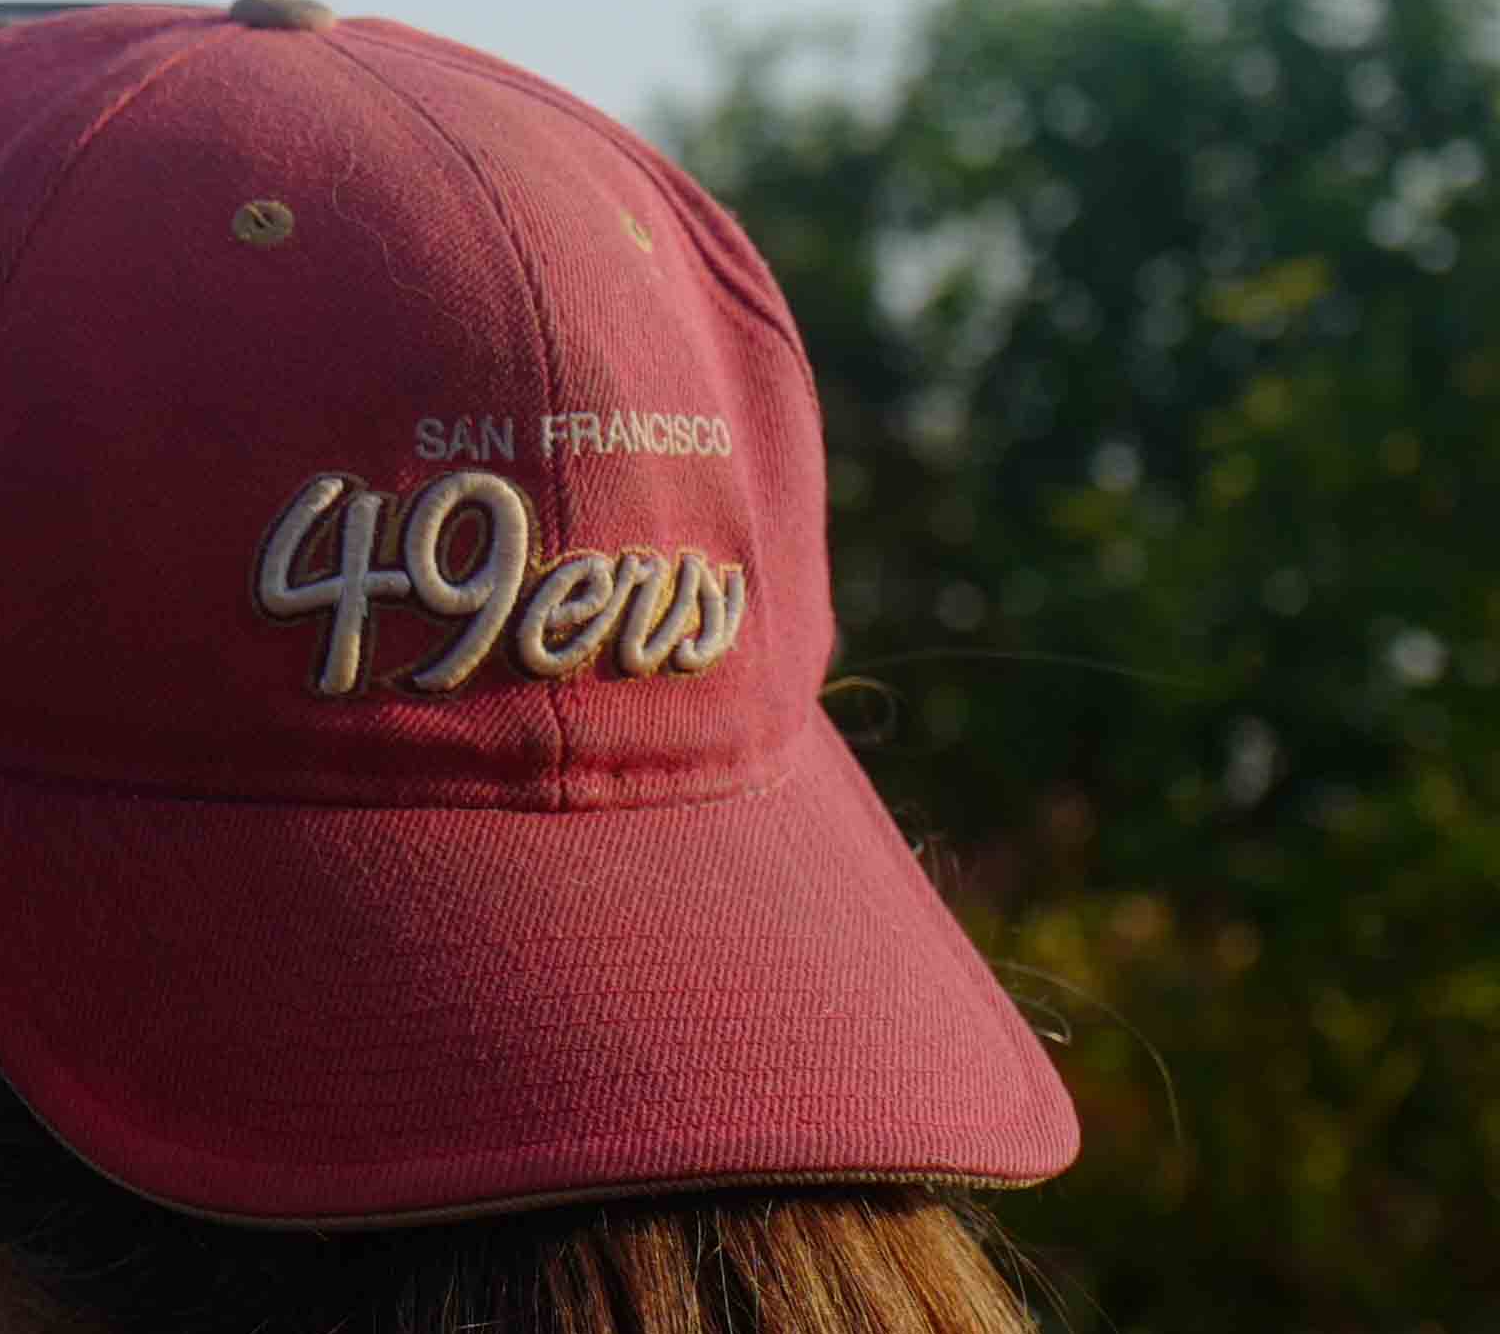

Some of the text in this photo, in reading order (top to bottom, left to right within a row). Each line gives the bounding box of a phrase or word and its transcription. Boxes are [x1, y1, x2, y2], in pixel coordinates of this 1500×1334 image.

[415, 410, 732, 460] SAN FRANCISCO
[256, 471, 745, 695] 49ers
